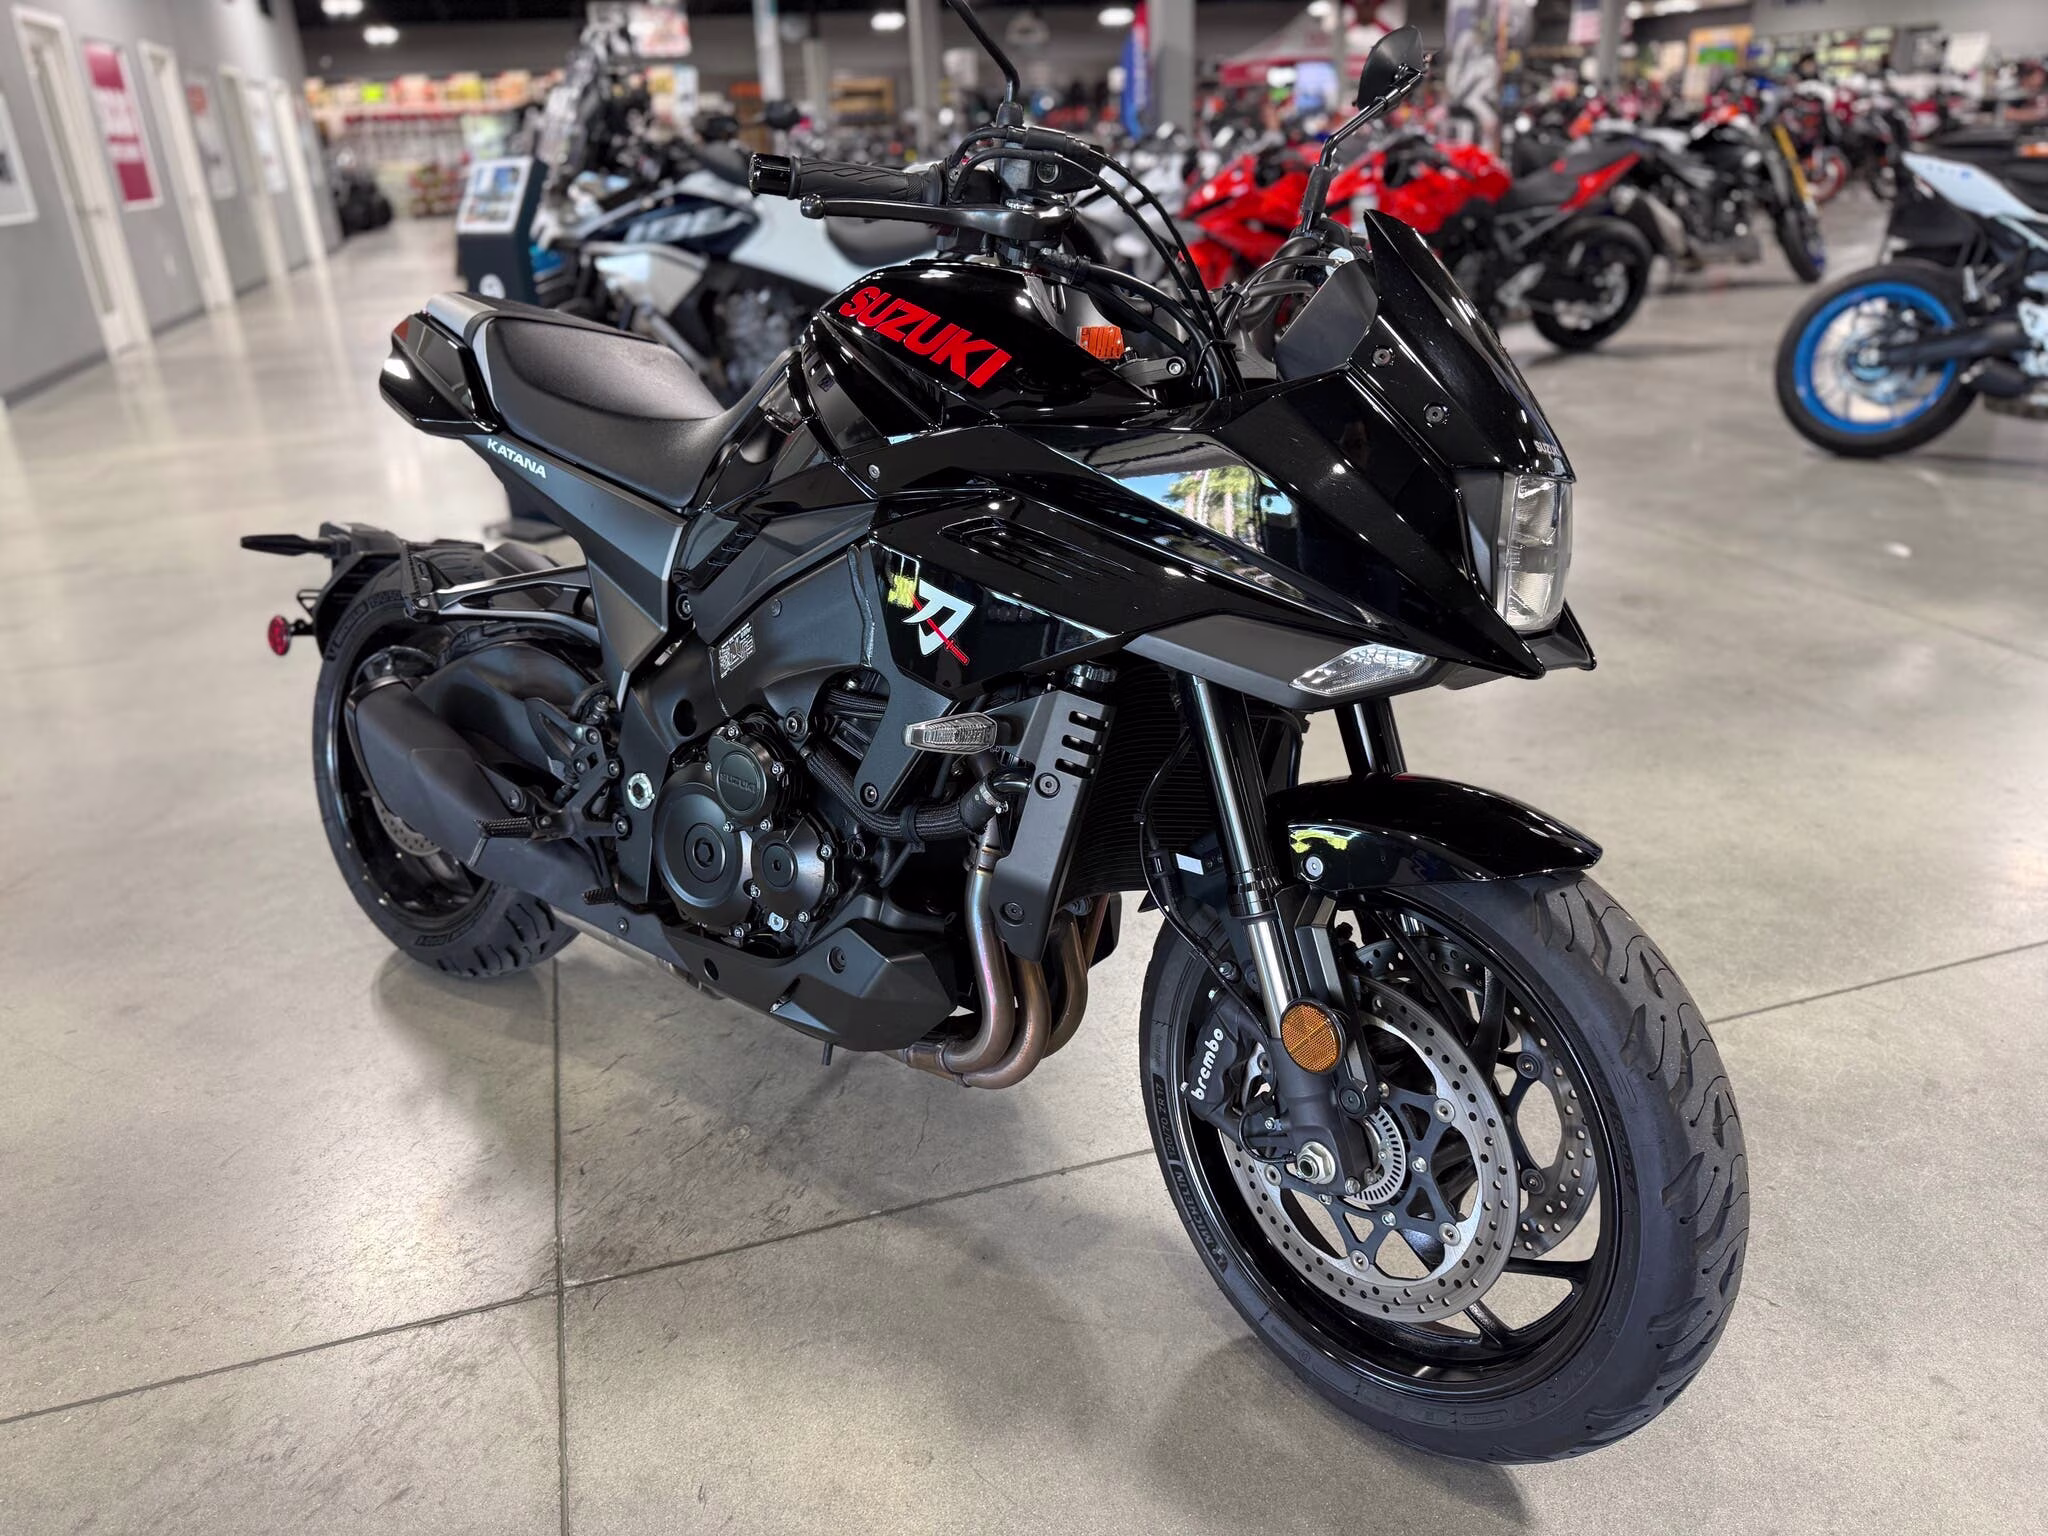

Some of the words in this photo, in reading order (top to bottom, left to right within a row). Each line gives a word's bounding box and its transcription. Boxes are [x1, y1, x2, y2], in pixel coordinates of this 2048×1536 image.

[839, 286, 1012, 388] SUZUKI
[487, 438, 546, 479] KATANA
[1191, 1028, 1224, 1101] brembo
[1175, 1171, 1214, 1244] MICHELIN
